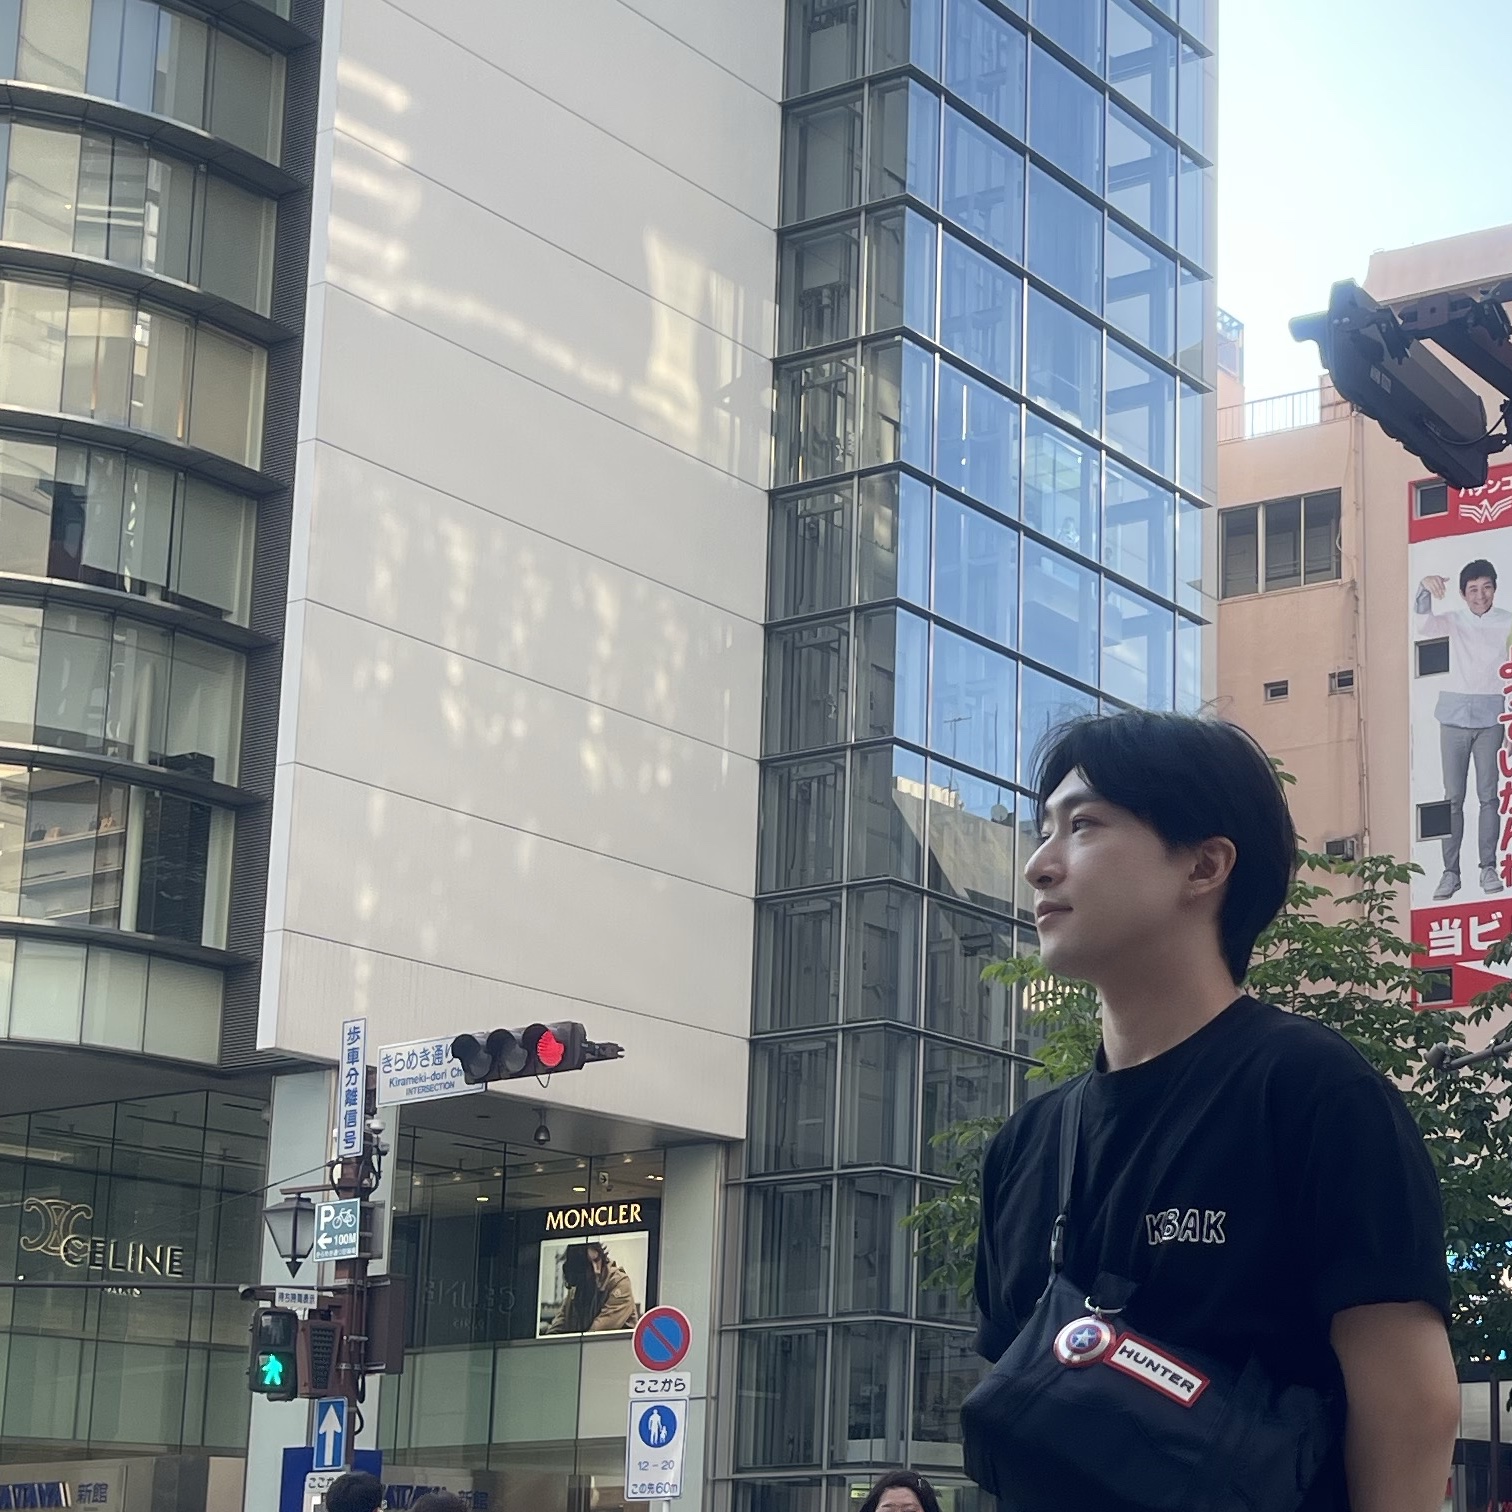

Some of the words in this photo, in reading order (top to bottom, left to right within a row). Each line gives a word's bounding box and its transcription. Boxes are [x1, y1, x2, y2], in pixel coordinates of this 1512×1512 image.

[343, 1026, 361, 1150] 歩車分離信号
[405, 1081, 455, 1096] INTERSECTION
[320, 1205, 335, 1231] P
[545, 1203, 642, 1231] MONCLER
[334, 1233, 357, 1246] 100M
[60, 1234, 184, 1278] CELINE
[1118, 1345, 1195, 1393] HUNTER
[634, 1378, 686, 1393] ここから
[631, 1482, 678, 1495] この先60m
